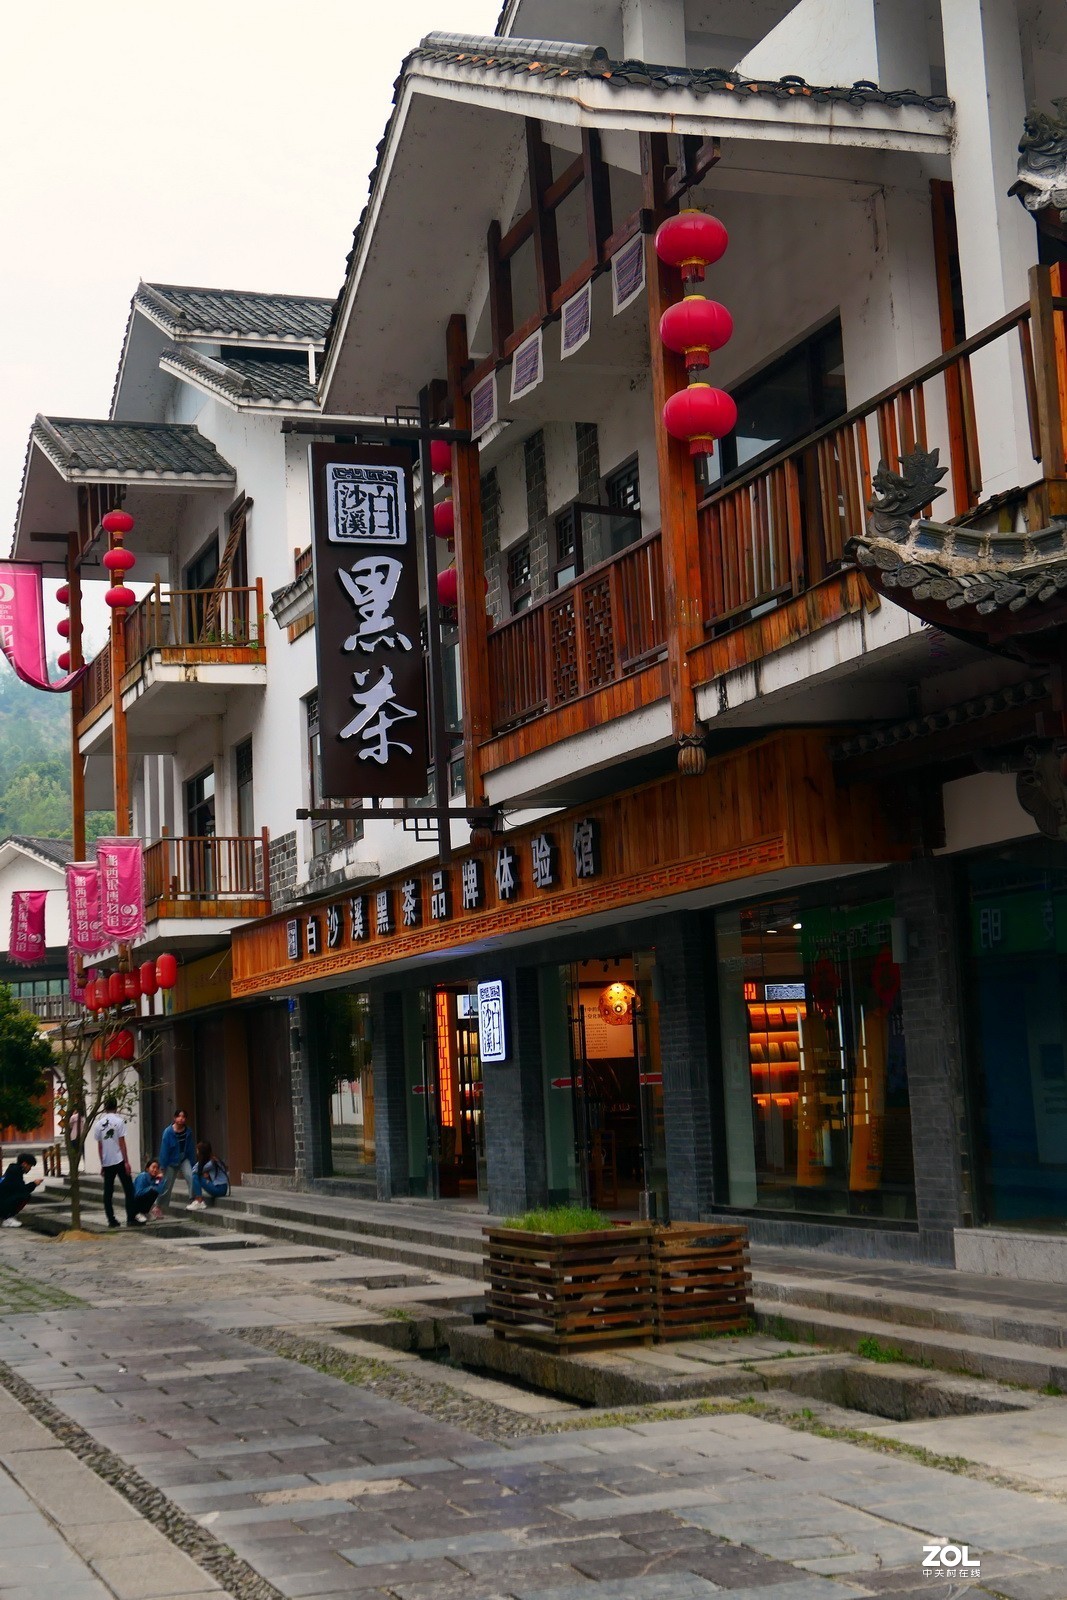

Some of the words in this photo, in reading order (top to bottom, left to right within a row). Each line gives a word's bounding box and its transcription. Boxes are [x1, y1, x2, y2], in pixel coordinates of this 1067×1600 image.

[338, 555, 417, 765] 黑茶
[306, 819, 596, 953] 白沙溪黑茶品牌体验馆
